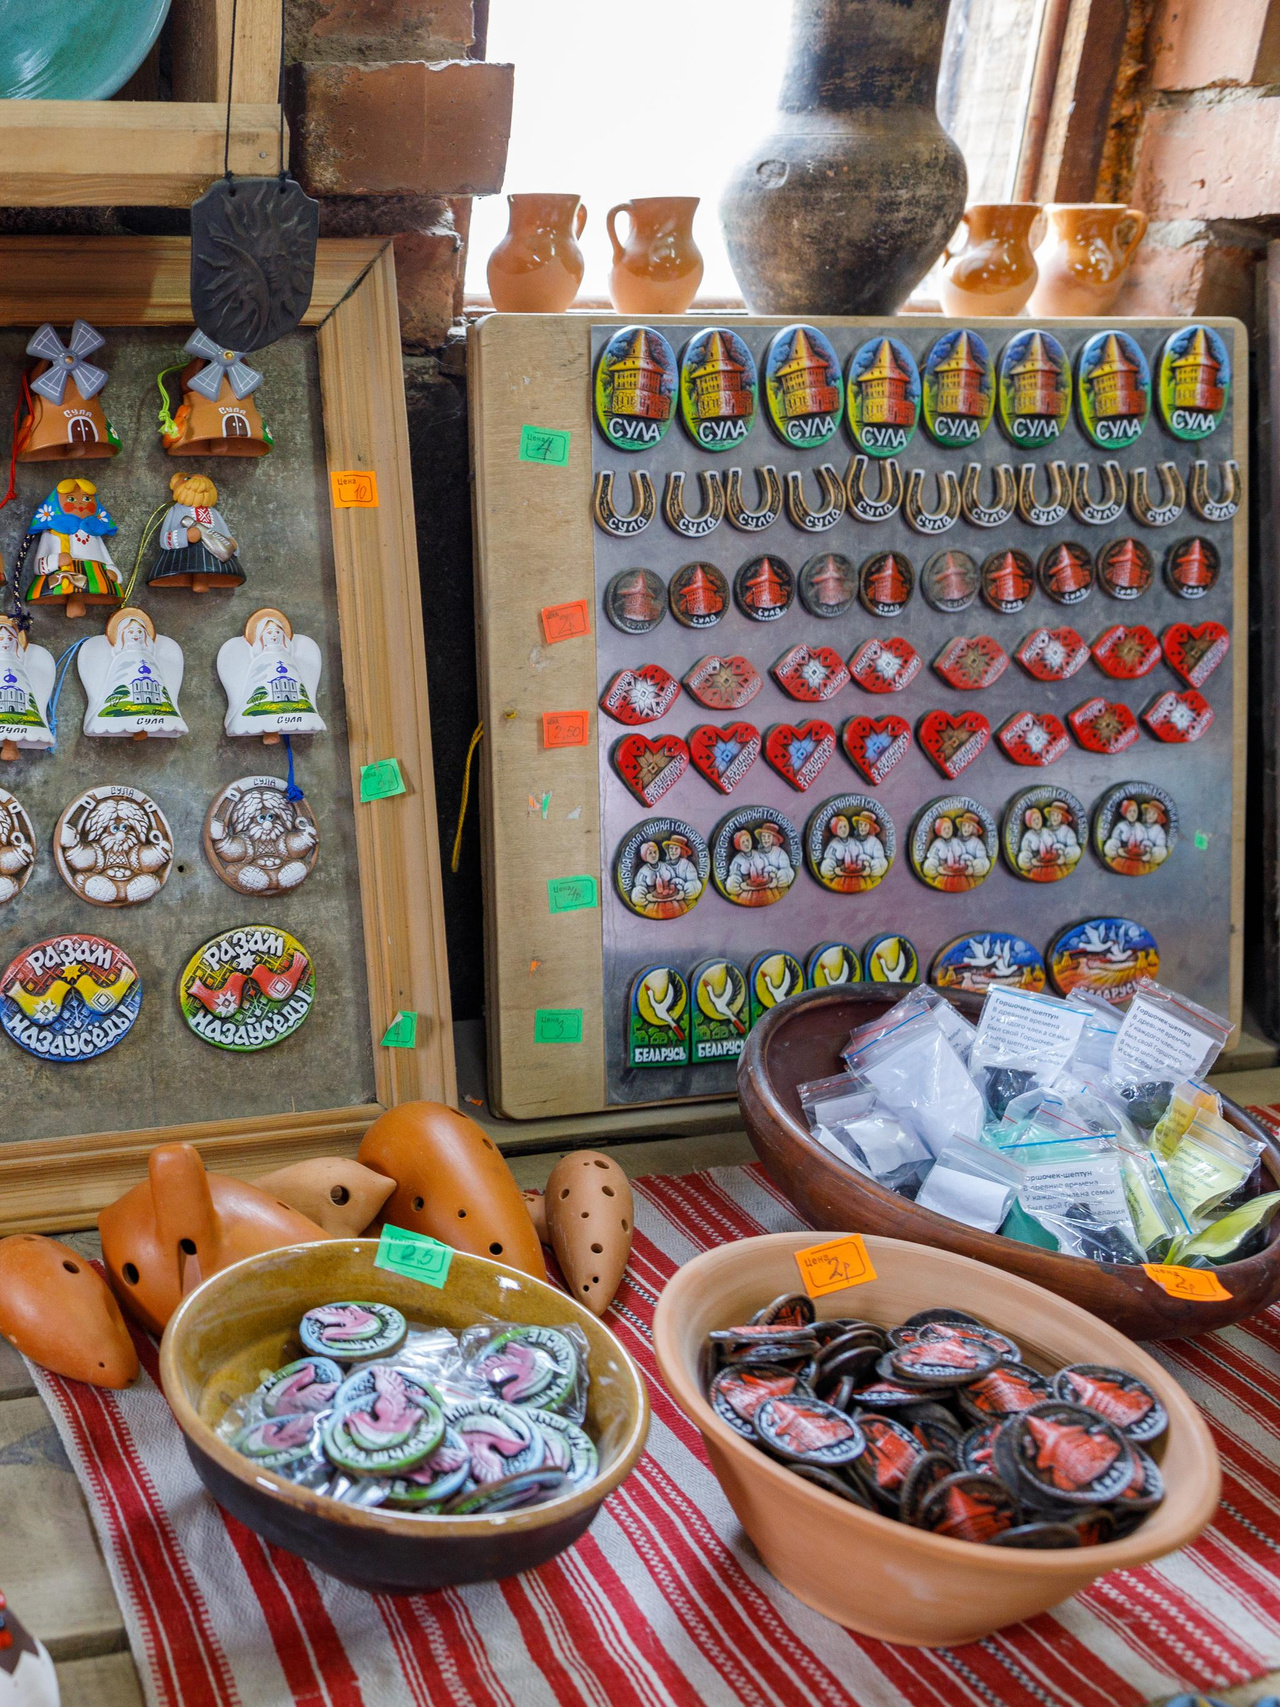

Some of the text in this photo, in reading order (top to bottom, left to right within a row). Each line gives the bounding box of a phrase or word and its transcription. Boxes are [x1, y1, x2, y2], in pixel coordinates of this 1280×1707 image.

[934, 416, 981, 438] СУЛА
[1172, 409, 1216, 431] СУЛА
[609, 418, 660, 441] СУЛА
[699, 419, 749, 442] СУЛА
[787, 416, 837, 440] СУЛА
[1013, 418, 1060, 438] СУЛА
[1096, 418, 1142, 440] СУЛА
[527, 434, 545, 442] Цена
[862, 426, 908, 447] СУЛА
[337, 478, 357, 486] Цена
[353, 484, 367, 499] 10
[253, 778, 277, 788] СУЛА
[110, 785, 136, 798] СУЛА
[737, 809, 762, 824] ЧАРКА
[644, 820, 670, 835] ЧАРКА
[674, 821, 705, 850] СКВАРКА
[698, 851, 708, 878] БЫЛА
[1028, 1017, 1060, 1030] времена
[1002, 1027, 1019, 1037] свой
[1124, 1030, 1137, 1041] Был
[1133, 1025, 1160, 1043] каждого
[635, 1047, 687, 1062] БЕЛАРУСЬ
[1025, 1171, 1092, 1182] оршочек-шептун
[804, 1254, 829, 1267] Цена
